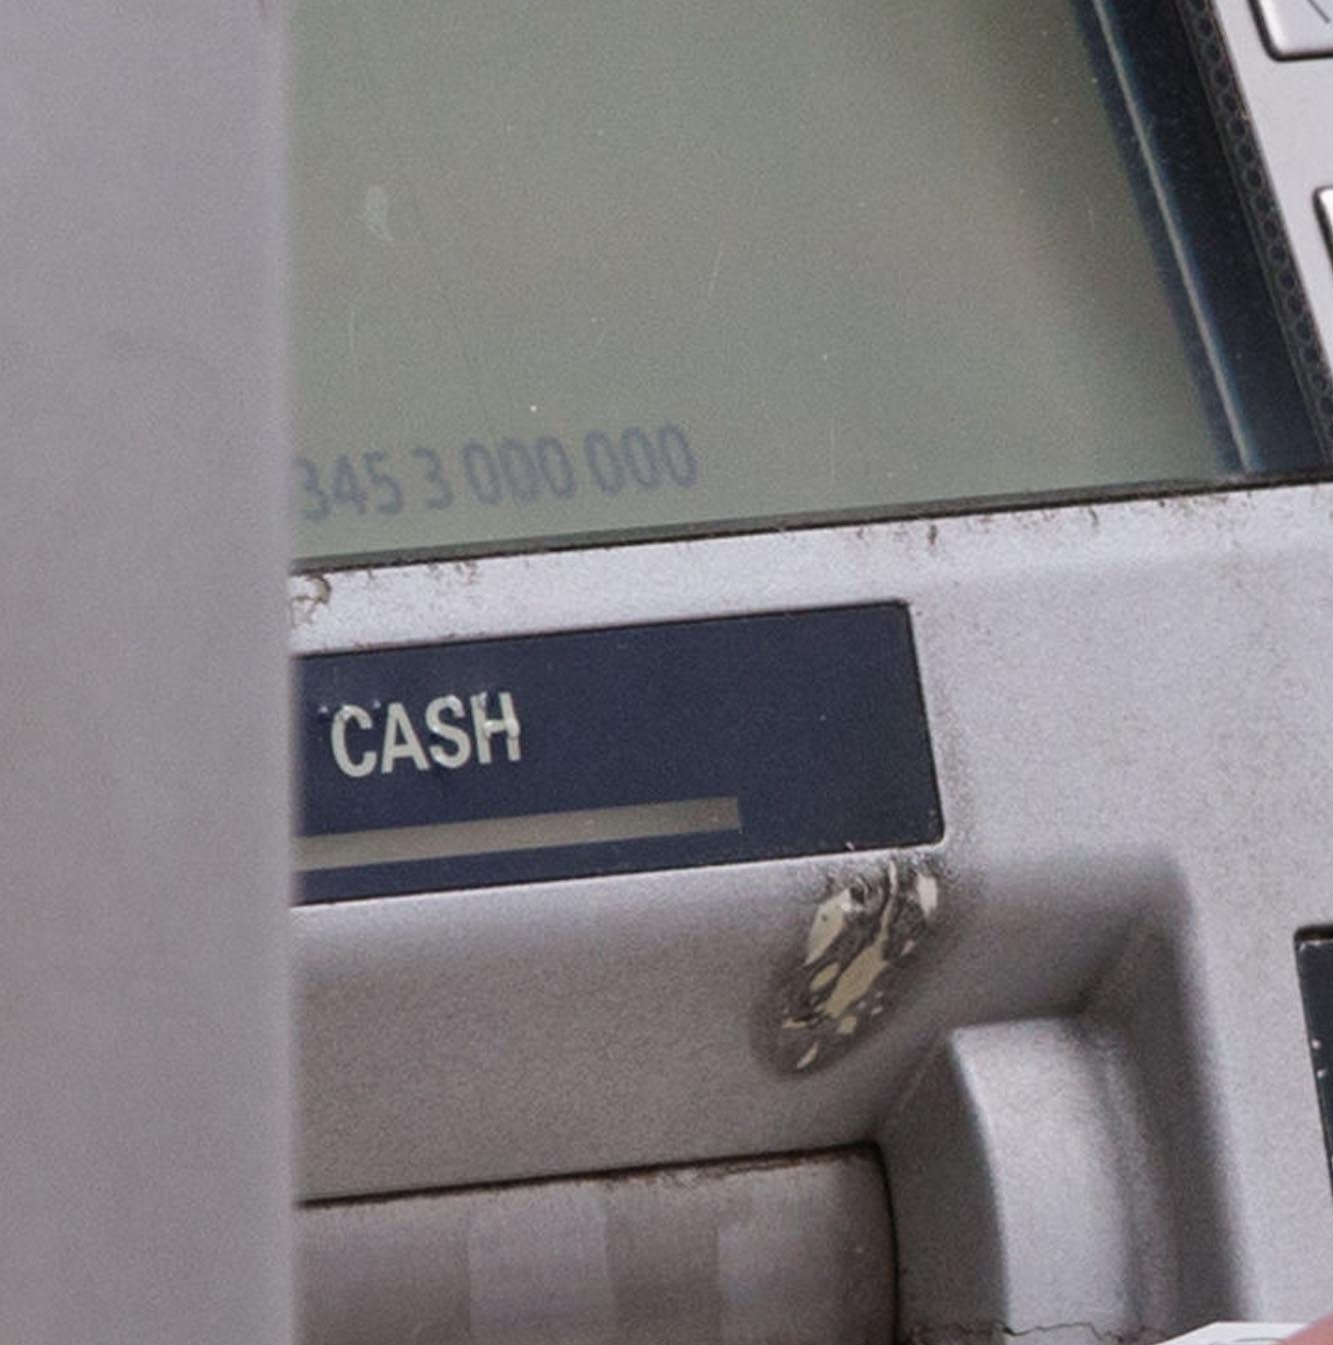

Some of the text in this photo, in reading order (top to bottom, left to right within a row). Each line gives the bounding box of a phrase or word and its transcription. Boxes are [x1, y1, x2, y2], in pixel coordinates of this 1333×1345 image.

[411, 446, 454, 510] 3
[461, 433, 577, 508] 000
[583, 420, 700, 497] 000
[329, 689, 522, 779] CASH
